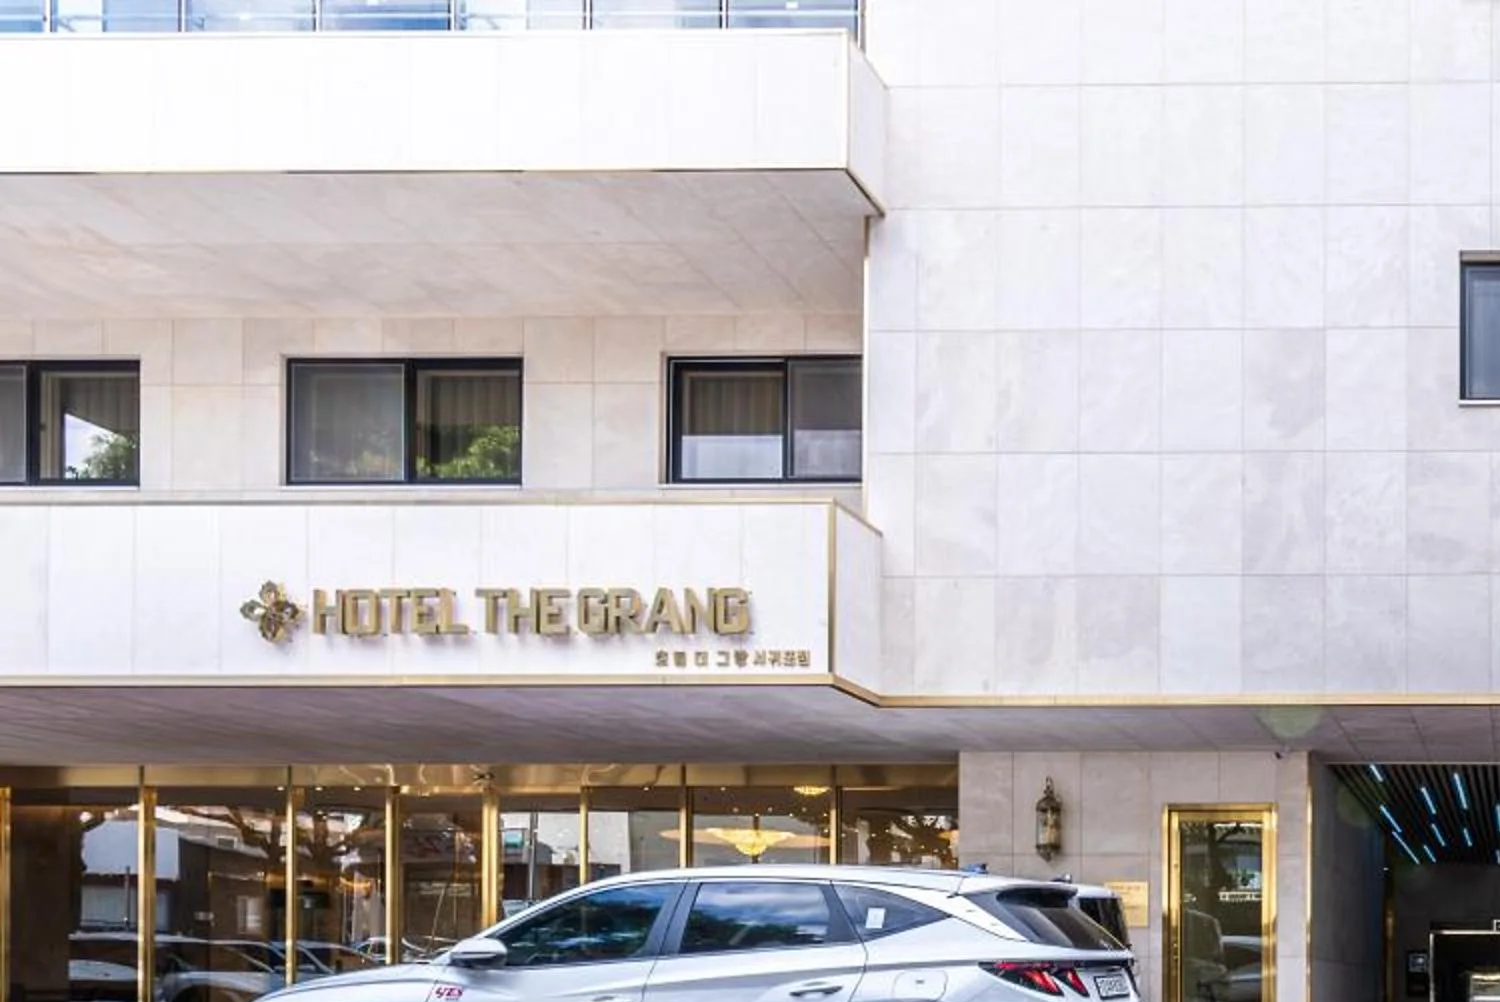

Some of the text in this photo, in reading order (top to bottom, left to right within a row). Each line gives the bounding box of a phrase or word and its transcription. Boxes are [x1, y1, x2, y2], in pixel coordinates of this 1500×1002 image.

[312, 586, 753, 636] HOTEL THE GRANG
